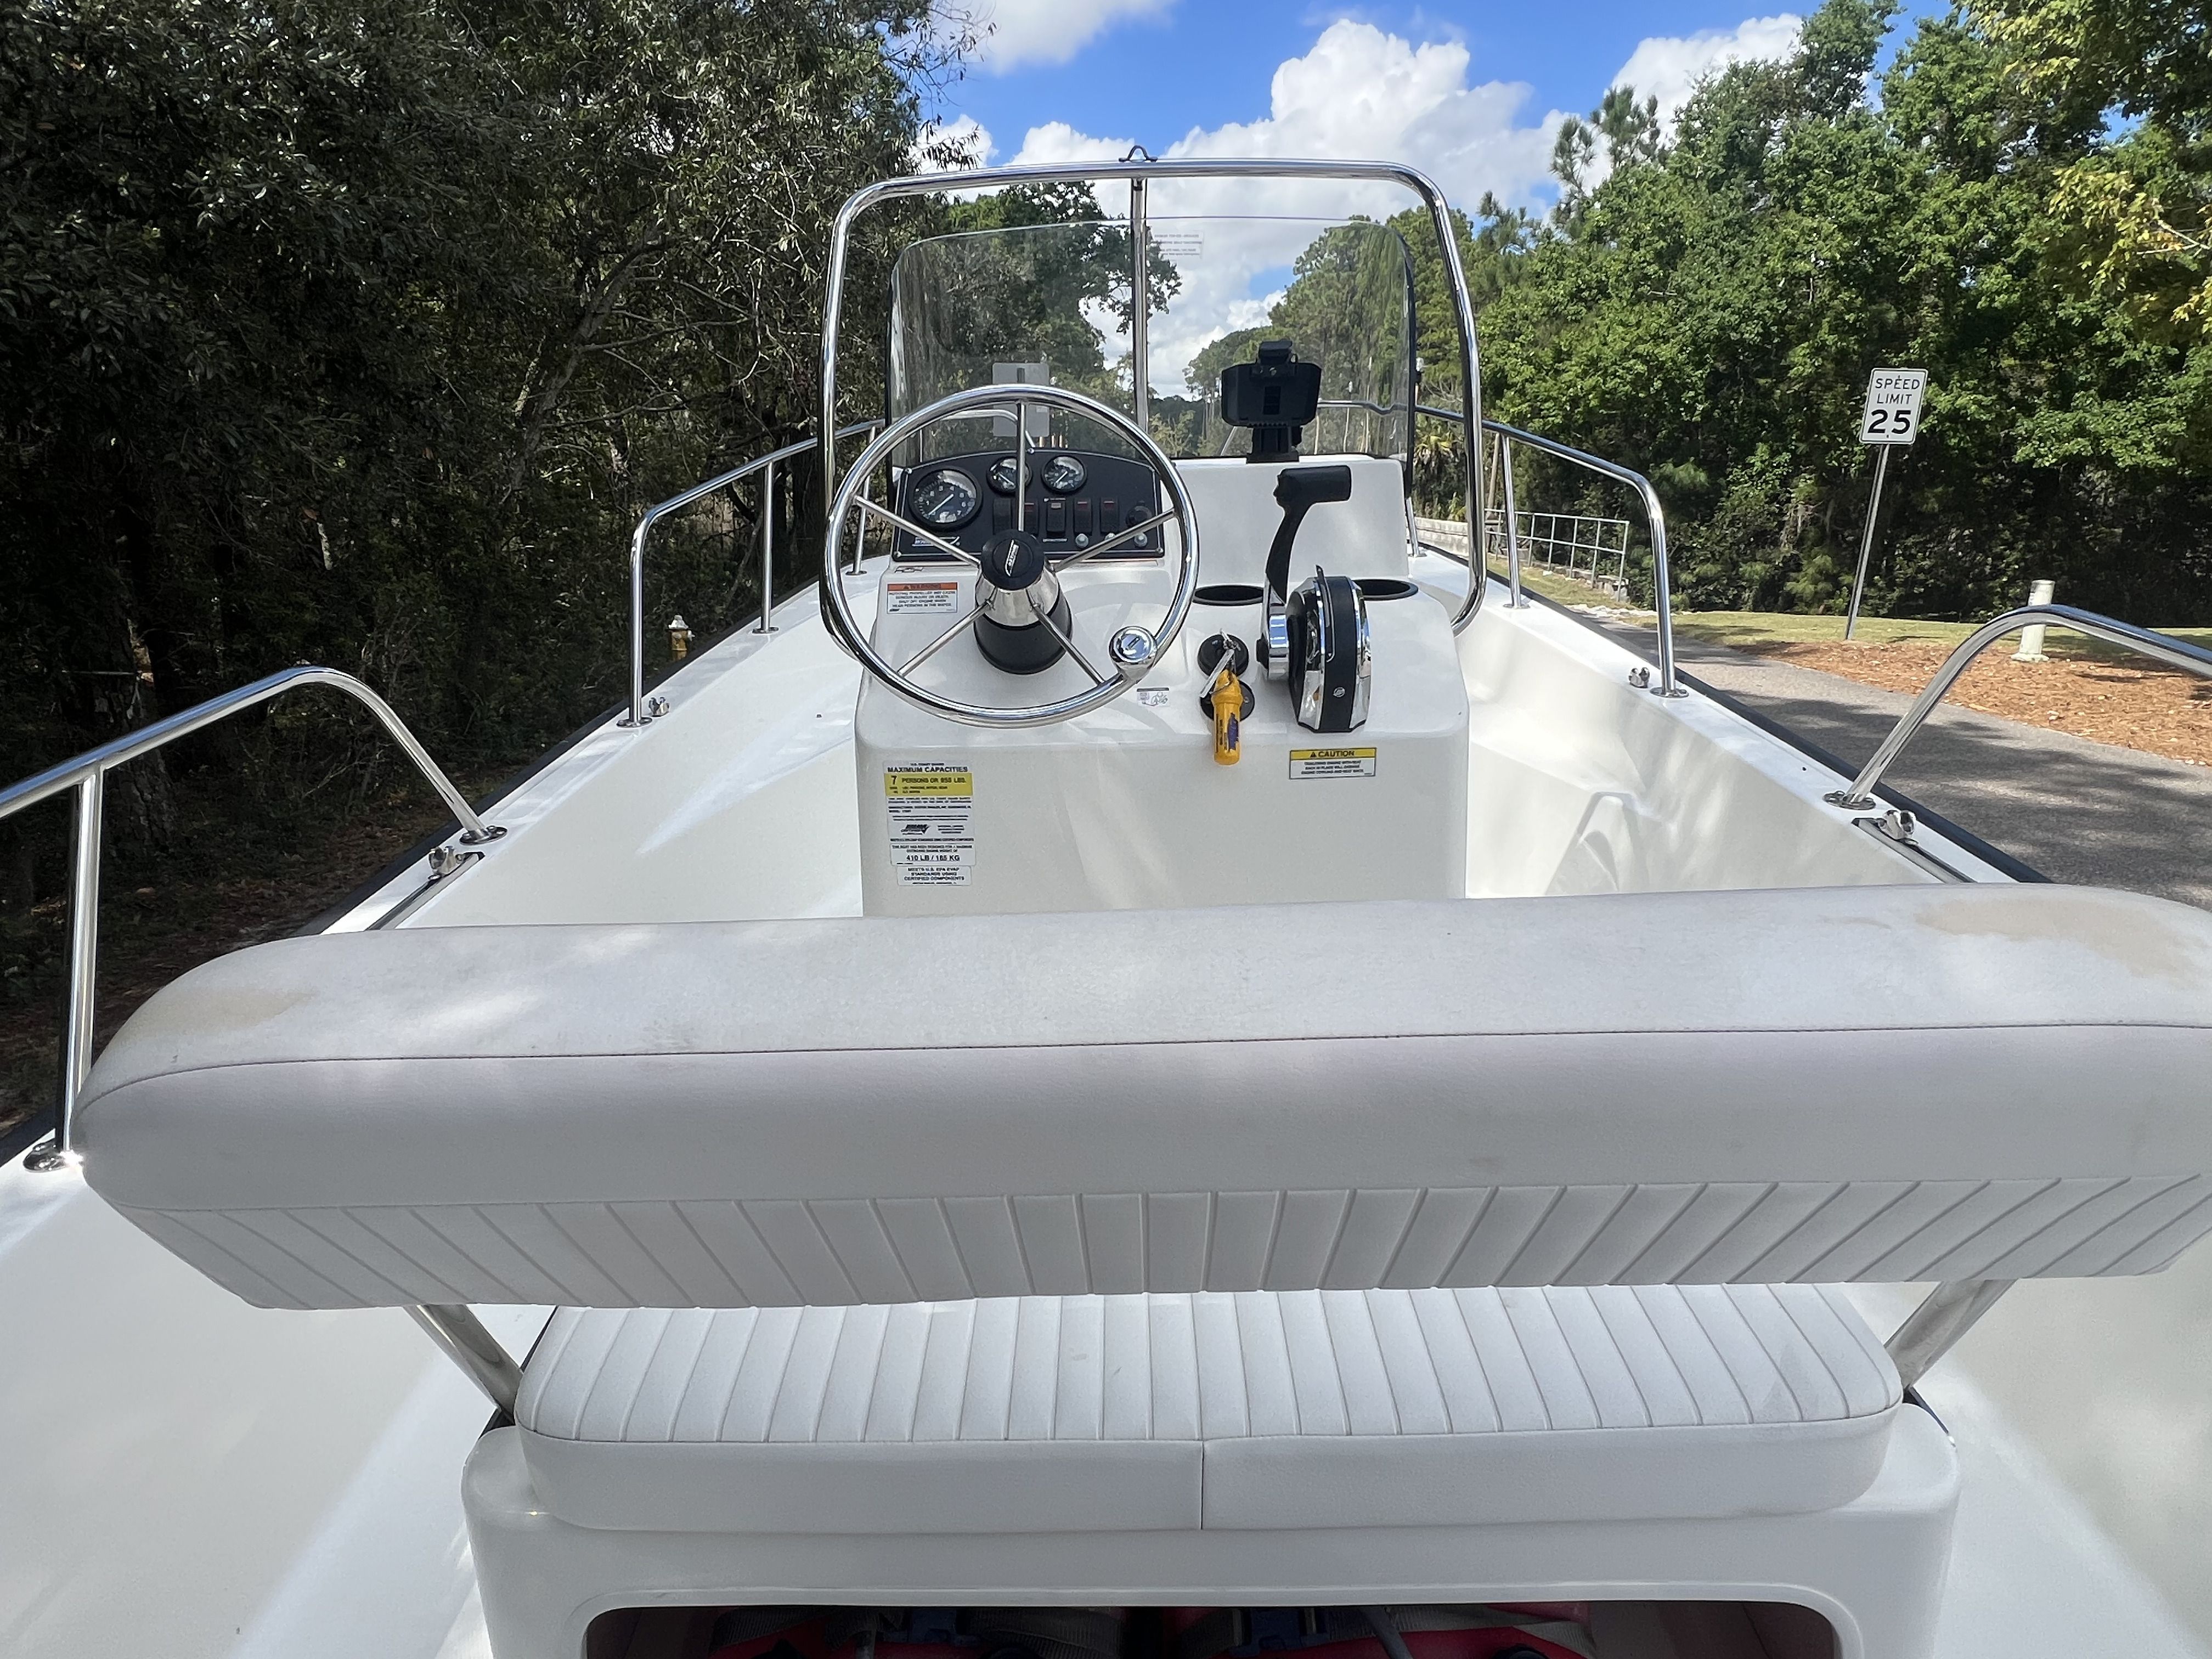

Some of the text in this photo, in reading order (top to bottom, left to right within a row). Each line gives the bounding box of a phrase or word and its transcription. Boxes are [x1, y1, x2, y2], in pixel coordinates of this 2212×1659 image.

[1875, 378, 1920, 390] SPEED
[1876, 393, 1912, 405] LIMIT
[1867, 409, 1911, 434] 25
[891, 775, 897, 785] 7
